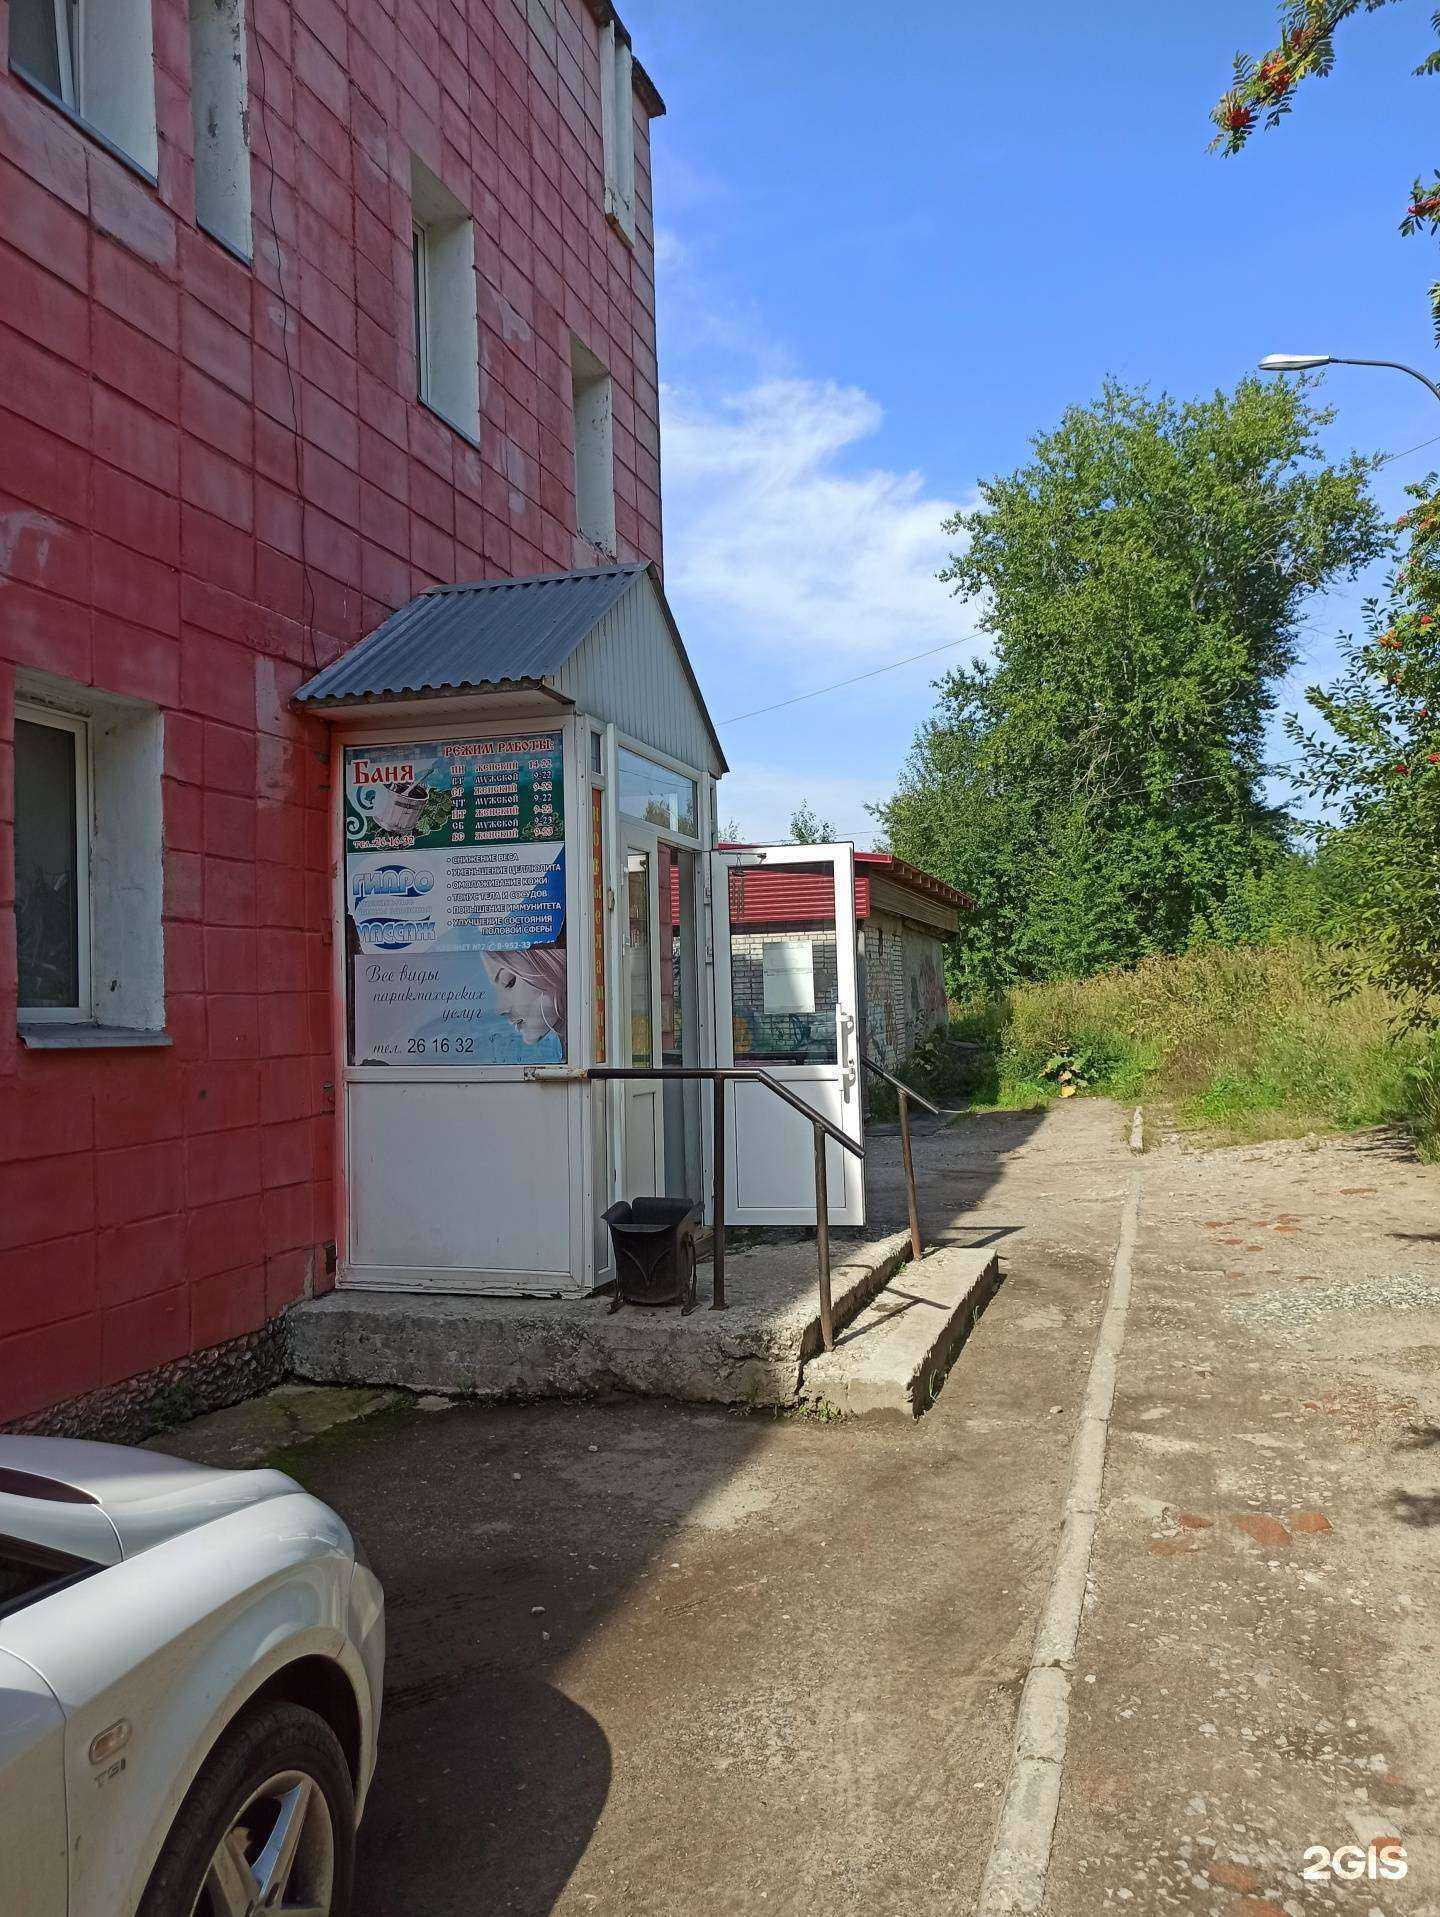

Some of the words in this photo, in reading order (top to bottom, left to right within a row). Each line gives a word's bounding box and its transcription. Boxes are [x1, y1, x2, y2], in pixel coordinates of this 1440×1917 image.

[444, 744, 494, 757] РЕЖИМ
[352, 760, 414, 785] Баня
[475, 760, 519, 773] ЖЕНСКИЙ
[475, 772, 519, 784] МУЖСКОЙ
[474, 783, 518, 796] ЖЕНСКИЙ
[475, 794, 519, 806] МУЖСКОЙ
[474, 805, 519, 818] ЖЕНСКИЙ
[475, 818, 519, 830] МУЖСКОЙ
[474, 829, 519, 841] ЖЕНСКИЙ
[452, 854, 497, 865] СНИЖЕНИЕ
[498, 852, 519, 862] ВЕСА
[452, 866, 507, 877] УМЕНЬШЕНИЕ
[509, 863, 561, 874] ЦЕЛЛЮЛИТА
[352, 869, 435, 896] ГИДРО
[452, 878, 521, 889] ОМОЛАЖИВАНИЕ
[522, 876, 548, 886] КОЖИ
[452, 892, 480, 902] ТОНУС
[481, 891, 500, 901] ТЕЛА
[502, 891, 509, 900] И
[510, 889, 548, 900] СОСУДОВ
[452, 904, 505, 915] ПОВЫШЕНИЕ
[506, 902, 562, 912] ИММУНИТЕТА
[452, 916, 502, 927] УЛУЧШЕНИЕ
[504, 914, 553, 925] СОСТОЯНИЯ
[481, 924, 522, 935] ПОЛОВОЙ
[523, 924, 553, 934] СФЕРЫ
[366, 964, 393, 982] Все
[399, 962, 440, 984] виды
[373, 985, 488, 1004] парикмахерских
[442, 1007, 483, 1022] услуг
[407, 1038, 426, 1054] 26
[432, 1037, 450, 1053] 16
[456, 1037, 474, 1053] 32
